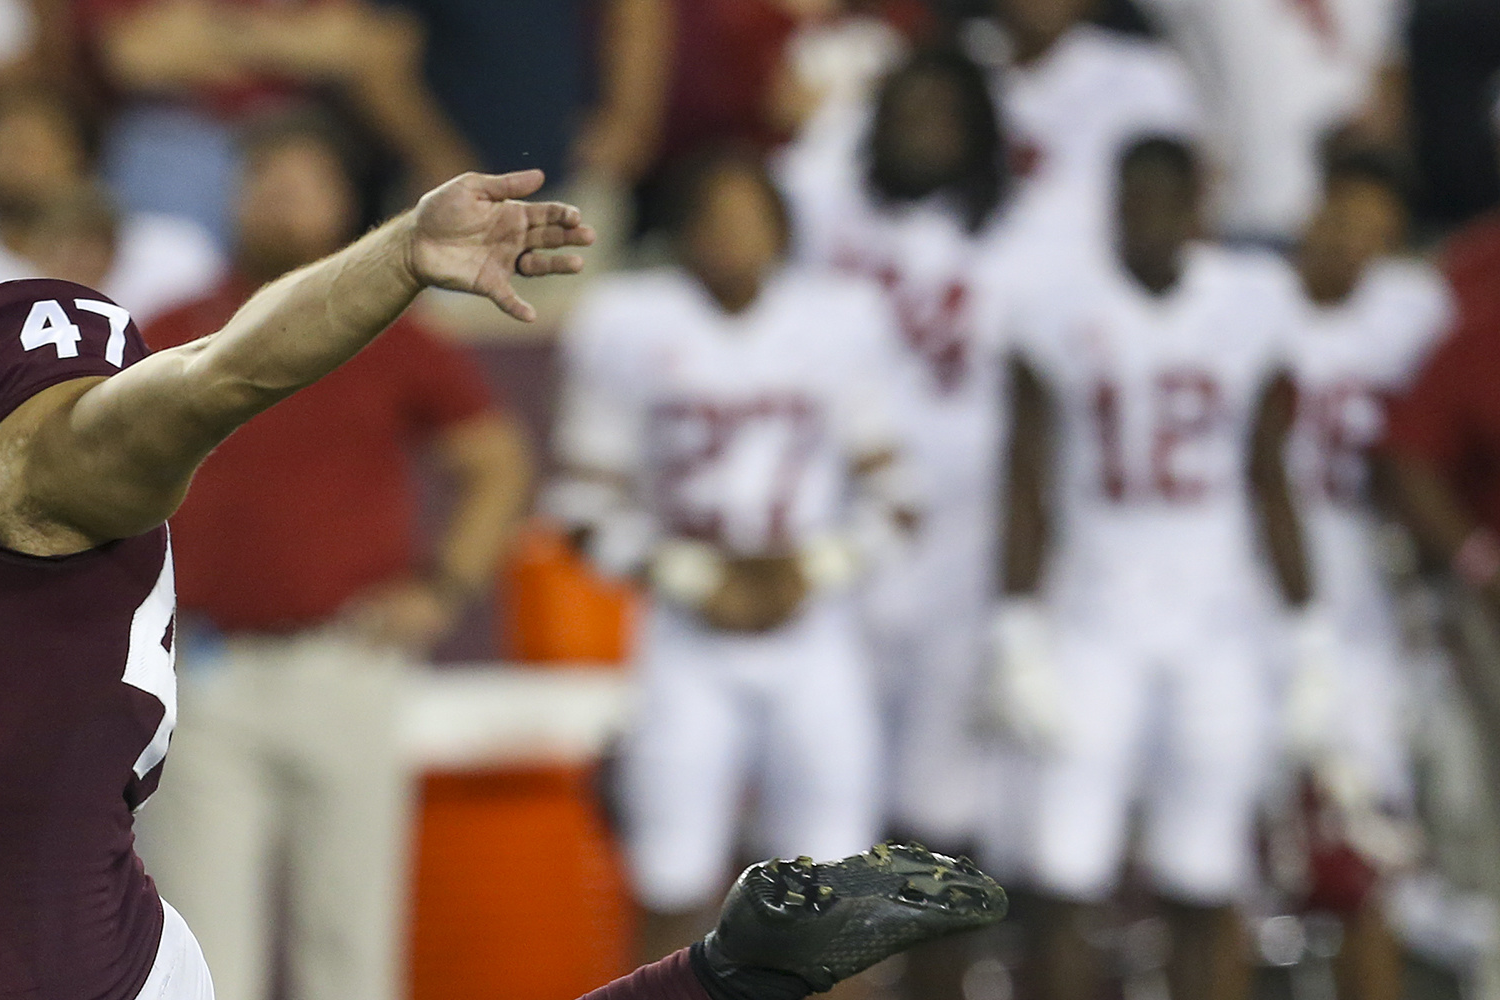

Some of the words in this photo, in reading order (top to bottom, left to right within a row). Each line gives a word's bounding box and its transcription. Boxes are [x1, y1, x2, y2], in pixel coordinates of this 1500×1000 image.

[19, 298, 130, 369] 47
[648, 394, 822, 550] 27
[1088, 364, 1224, 504] 12
